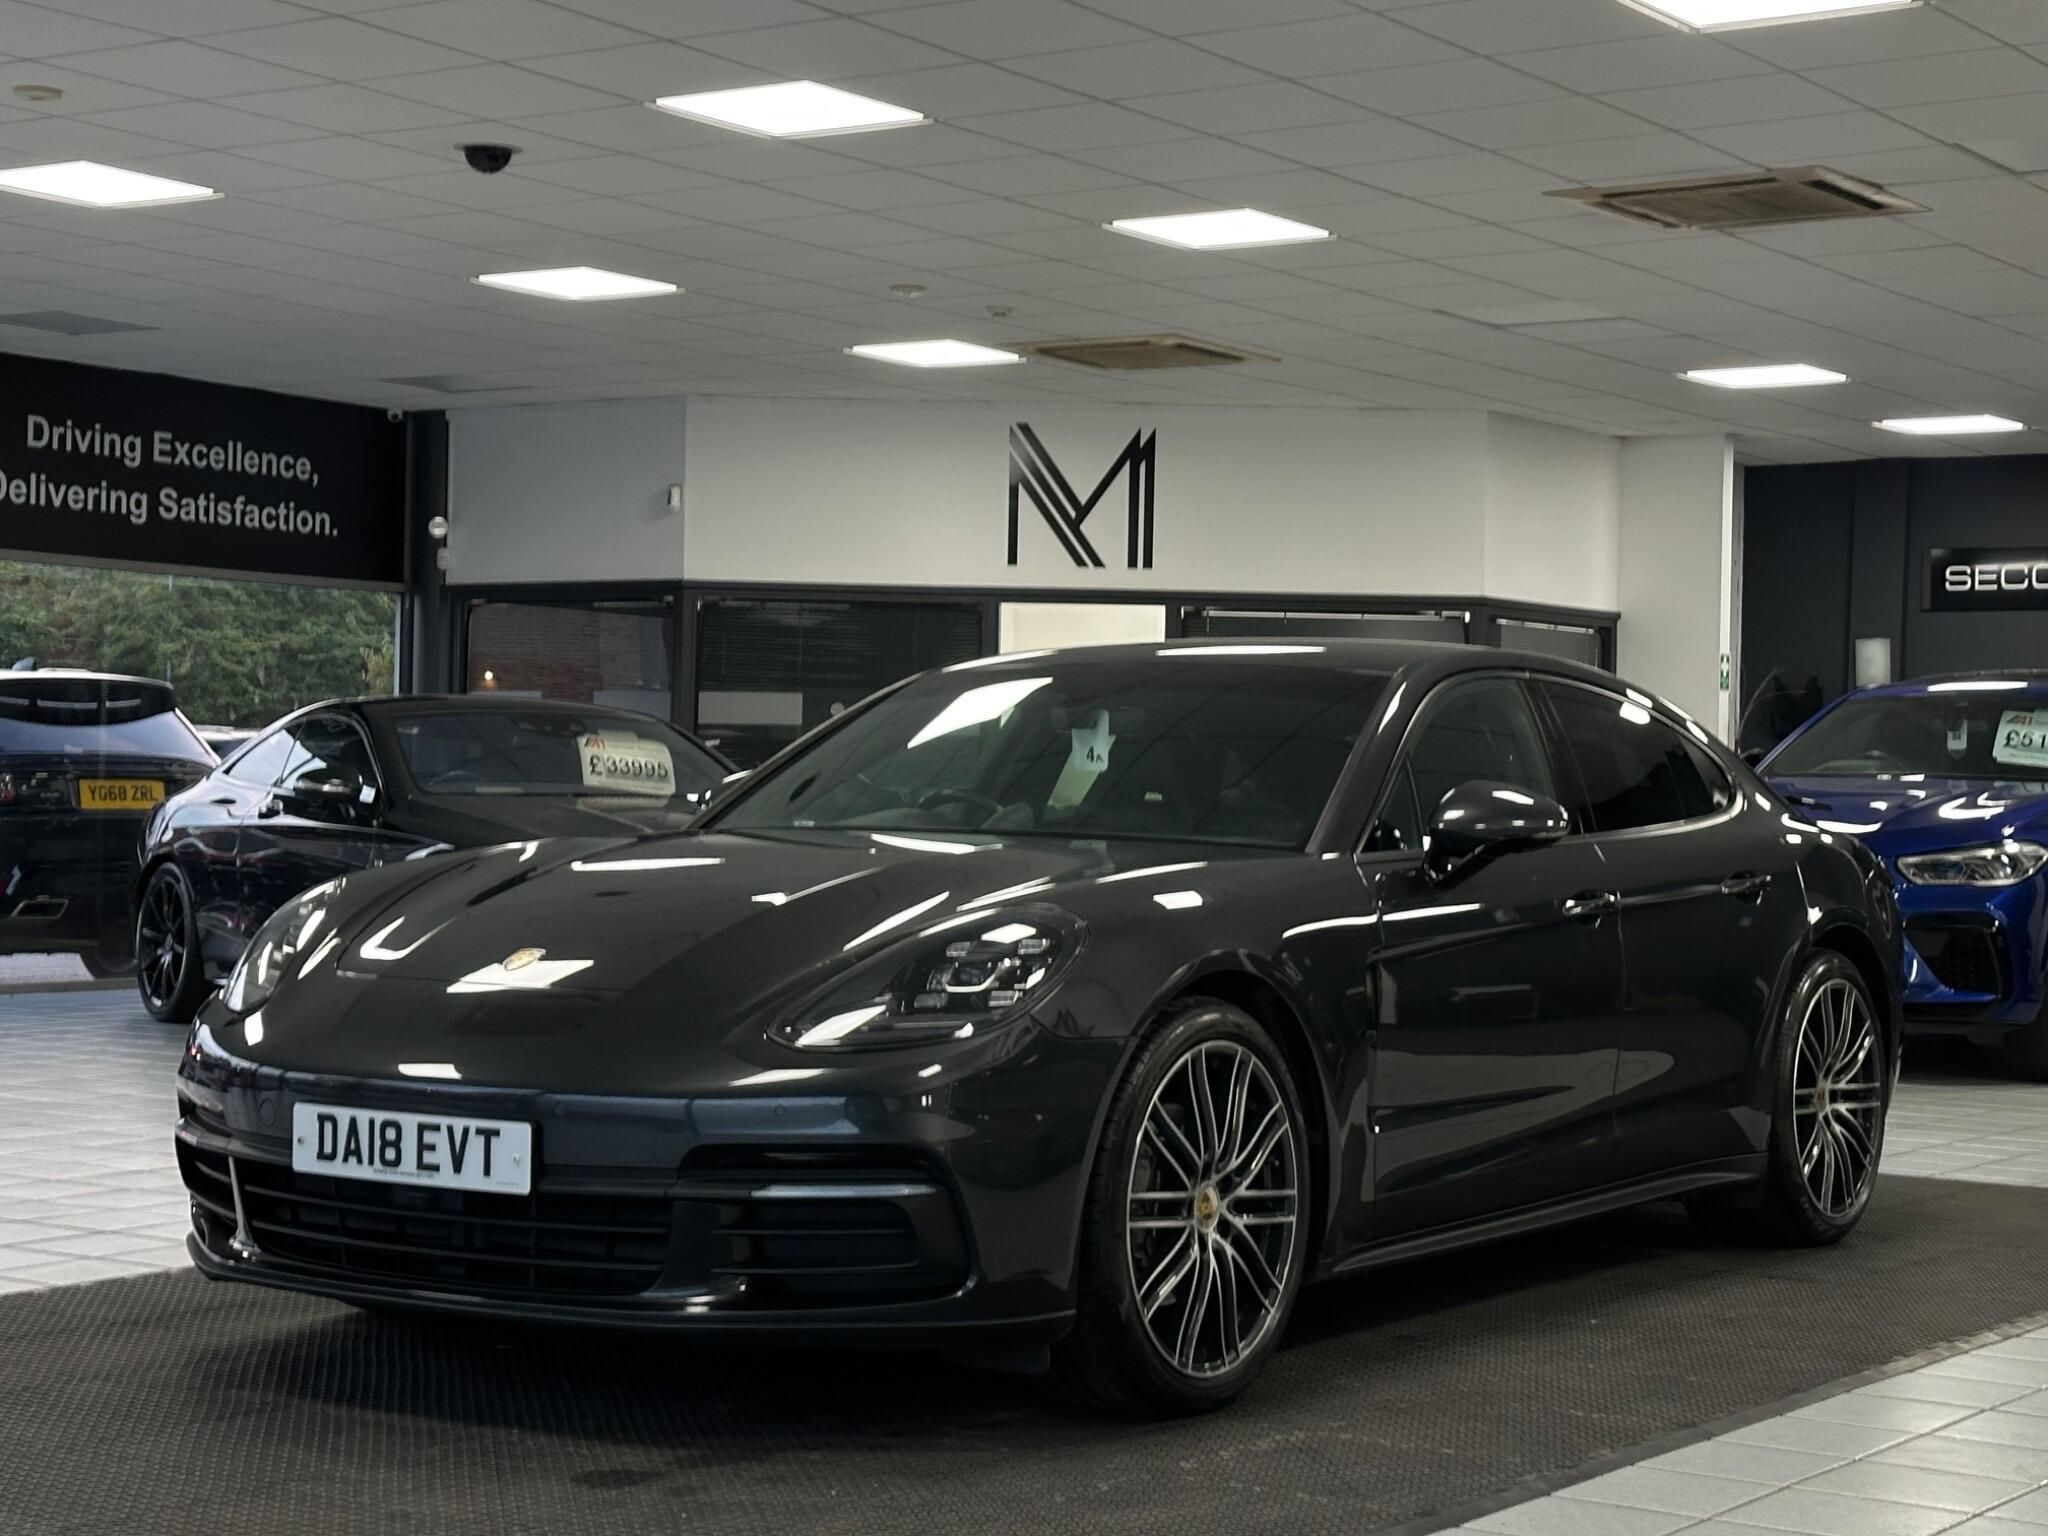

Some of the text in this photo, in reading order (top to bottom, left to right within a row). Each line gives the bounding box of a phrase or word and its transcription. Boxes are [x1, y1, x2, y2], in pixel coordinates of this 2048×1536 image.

[27, 414, 319, 488] Driving Excellence,
[158, 486, 339, 537] Satisfaction.
[589, 754, 669, 779] £33995
[316, 1112, 501, 1178] DA18 EVT
